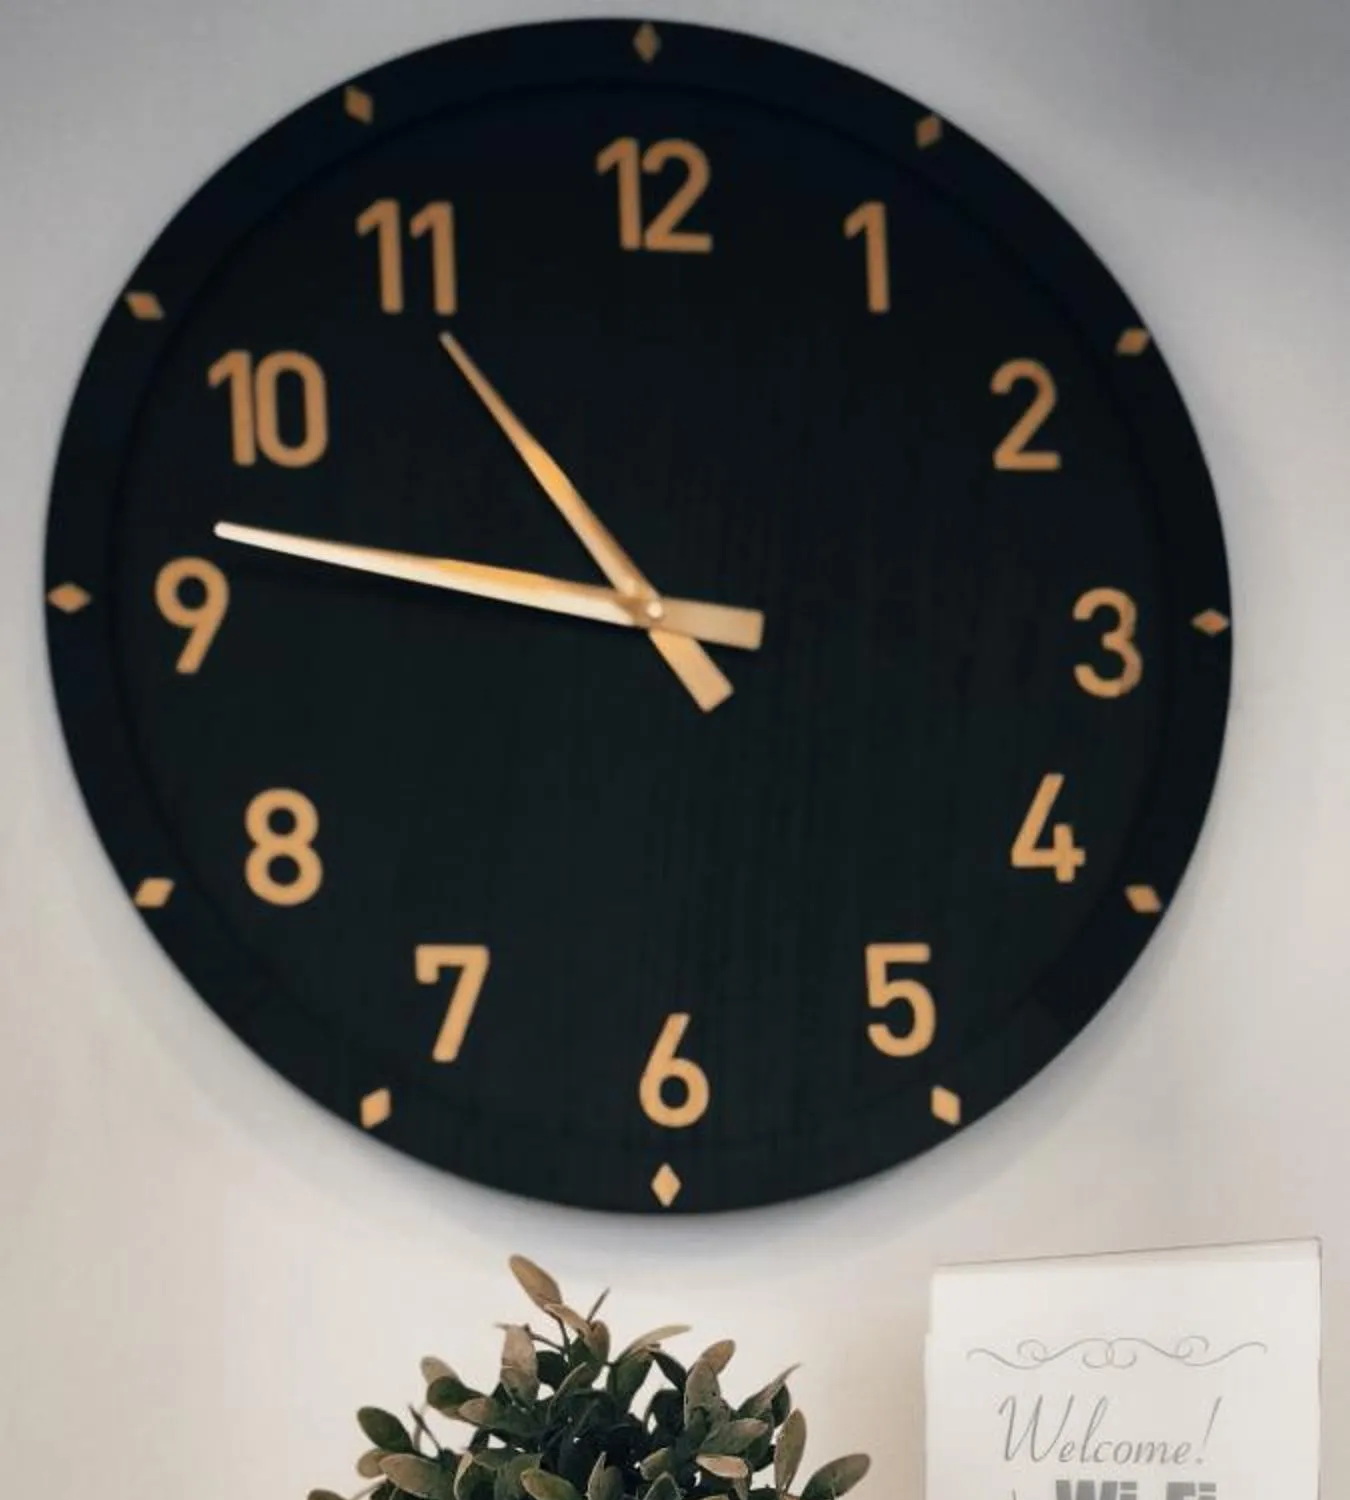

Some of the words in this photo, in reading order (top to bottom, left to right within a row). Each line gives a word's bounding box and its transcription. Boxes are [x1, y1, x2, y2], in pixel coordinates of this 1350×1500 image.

[598, 139, 711, 251] 12
[357, 201, 457, 315] 11
[846, 202, 889, 313] 1
[208, 351, 328, 467] 10
[991, 360, 1059, 470] 2
[154, 557, 229, 674] 9
[1073, 587, 1143, 698] 3
[244, 788, 323, 906] 8
[1010, 773, 1086, 883] 4
[414, 943, 490, 1063] 7
[864, 942, 936, 1058] 5
[638, 1012, 711, 1128] 6
[998, 1394, 1223, 1465] Welcome!
